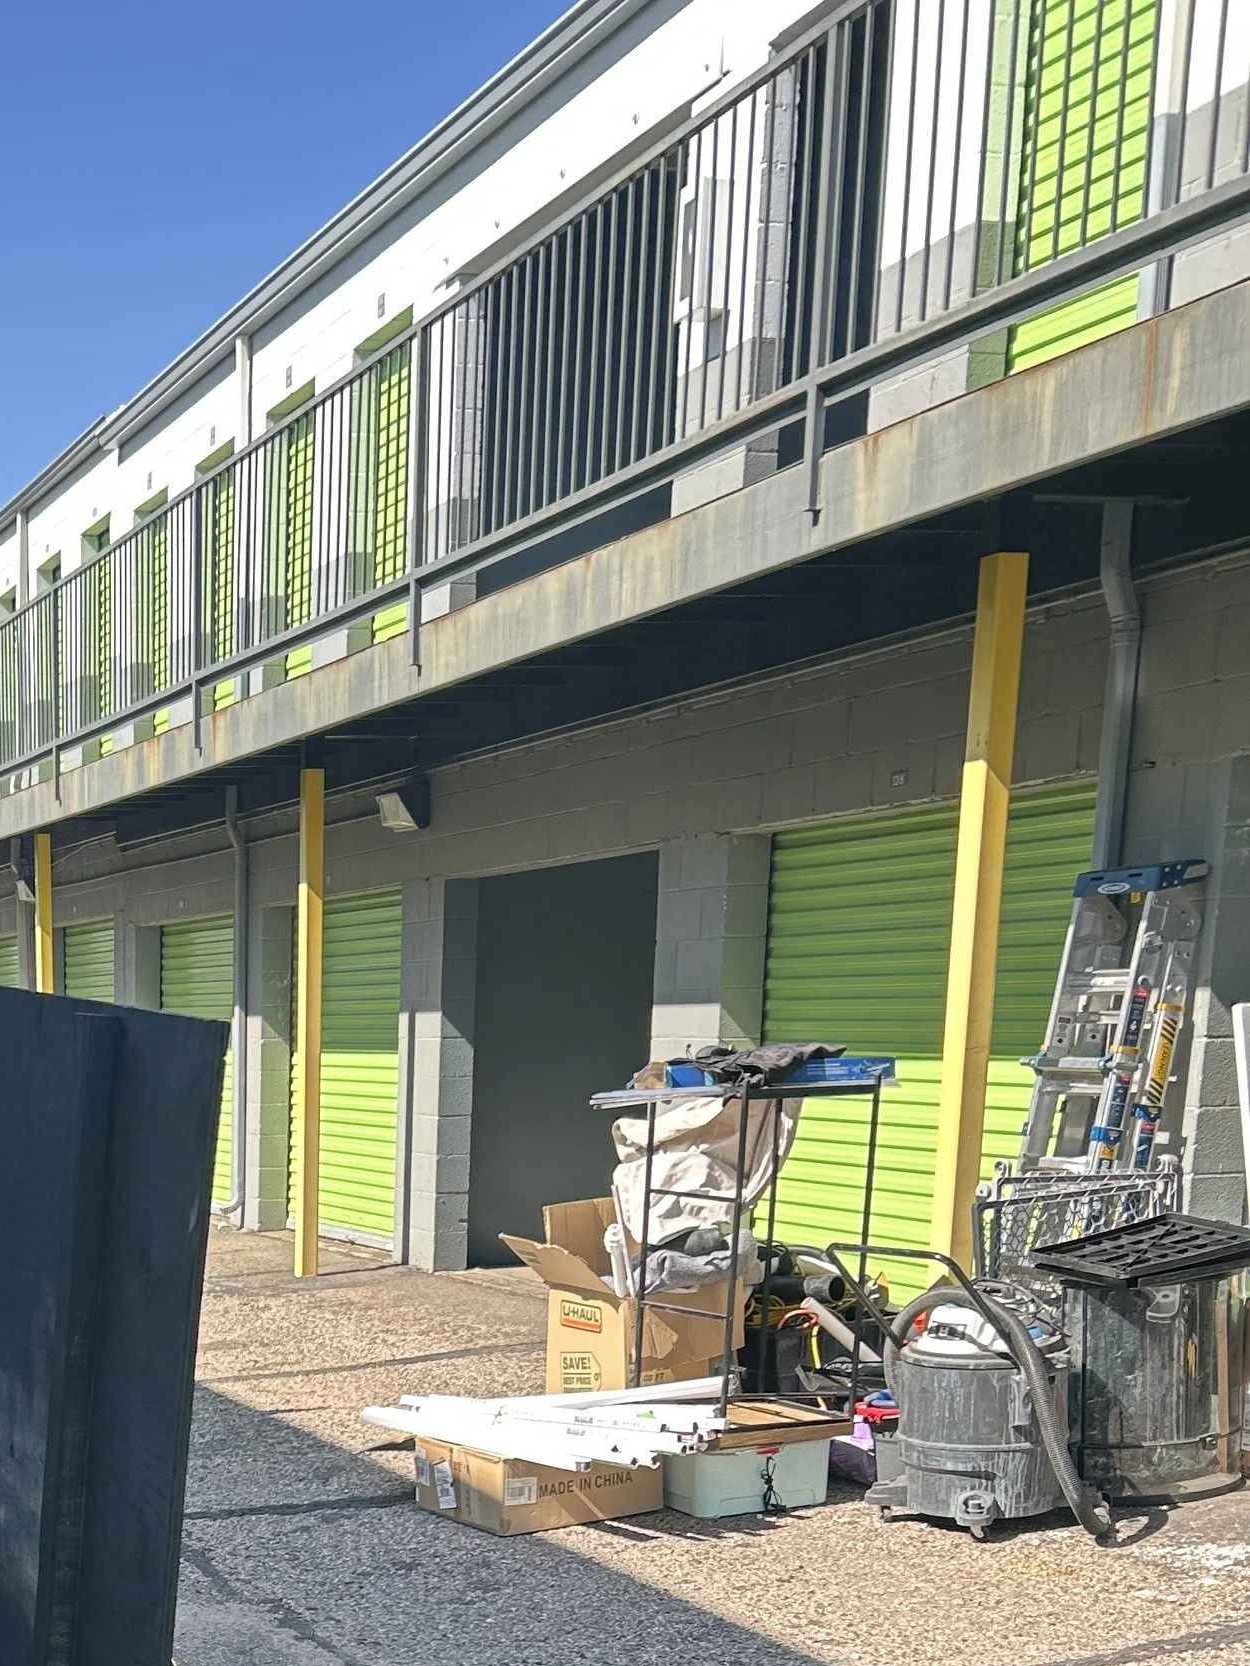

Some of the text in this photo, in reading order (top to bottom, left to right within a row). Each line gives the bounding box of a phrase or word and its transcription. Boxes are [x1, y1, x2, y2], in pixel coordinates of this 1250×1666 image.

[562, 1304, 600, 1323] U-HAUL
[562, 1356, 591, 1370] SAVE!
[539, 1480, 574, 1498] MADE
[579, 1477, 592, 1492] IN
[594, 1471, 633, 1488] CHINA
